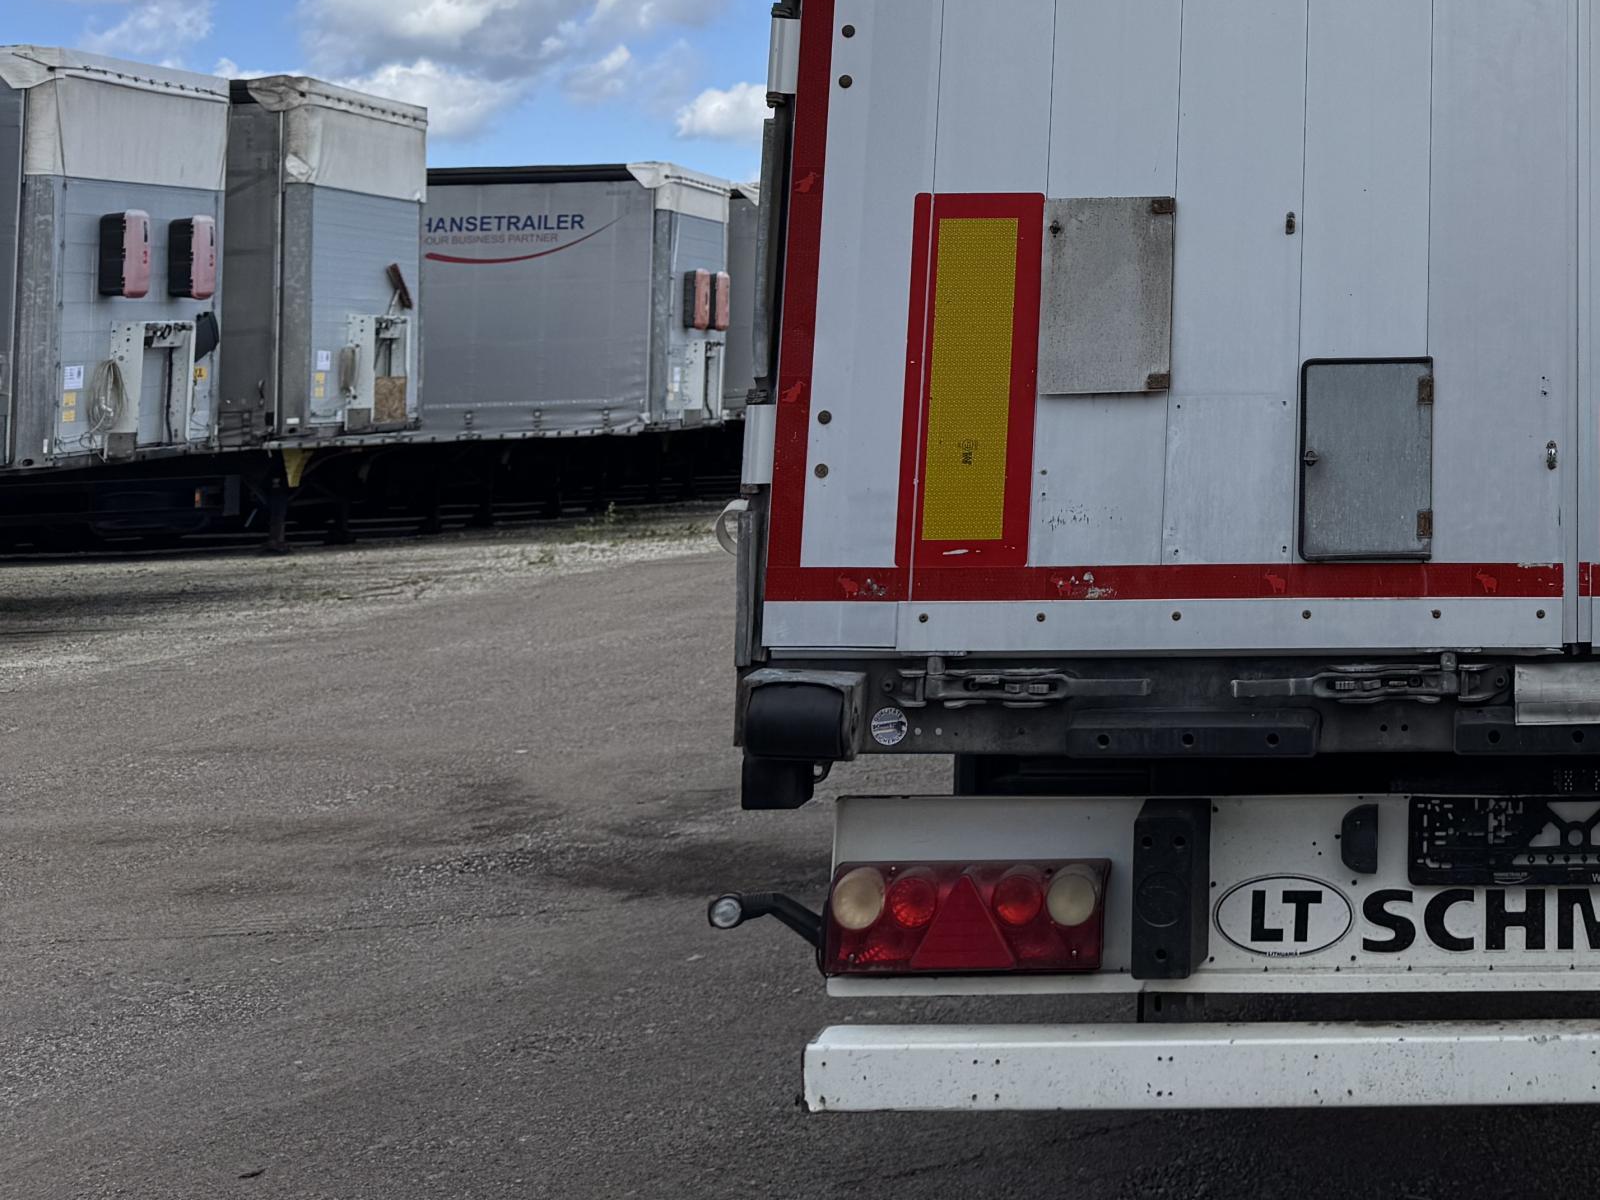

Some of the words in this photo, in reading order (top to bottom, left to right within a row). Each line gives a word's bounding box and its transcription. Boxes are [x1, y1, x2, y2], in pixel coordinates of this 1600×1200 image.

[424, 235, 449, 246] OUR
[451, 233, 504, 245] BUSINESS
[508, 233, 559, 243] PARTNER
[1250, 890, 1322, 943] LT
